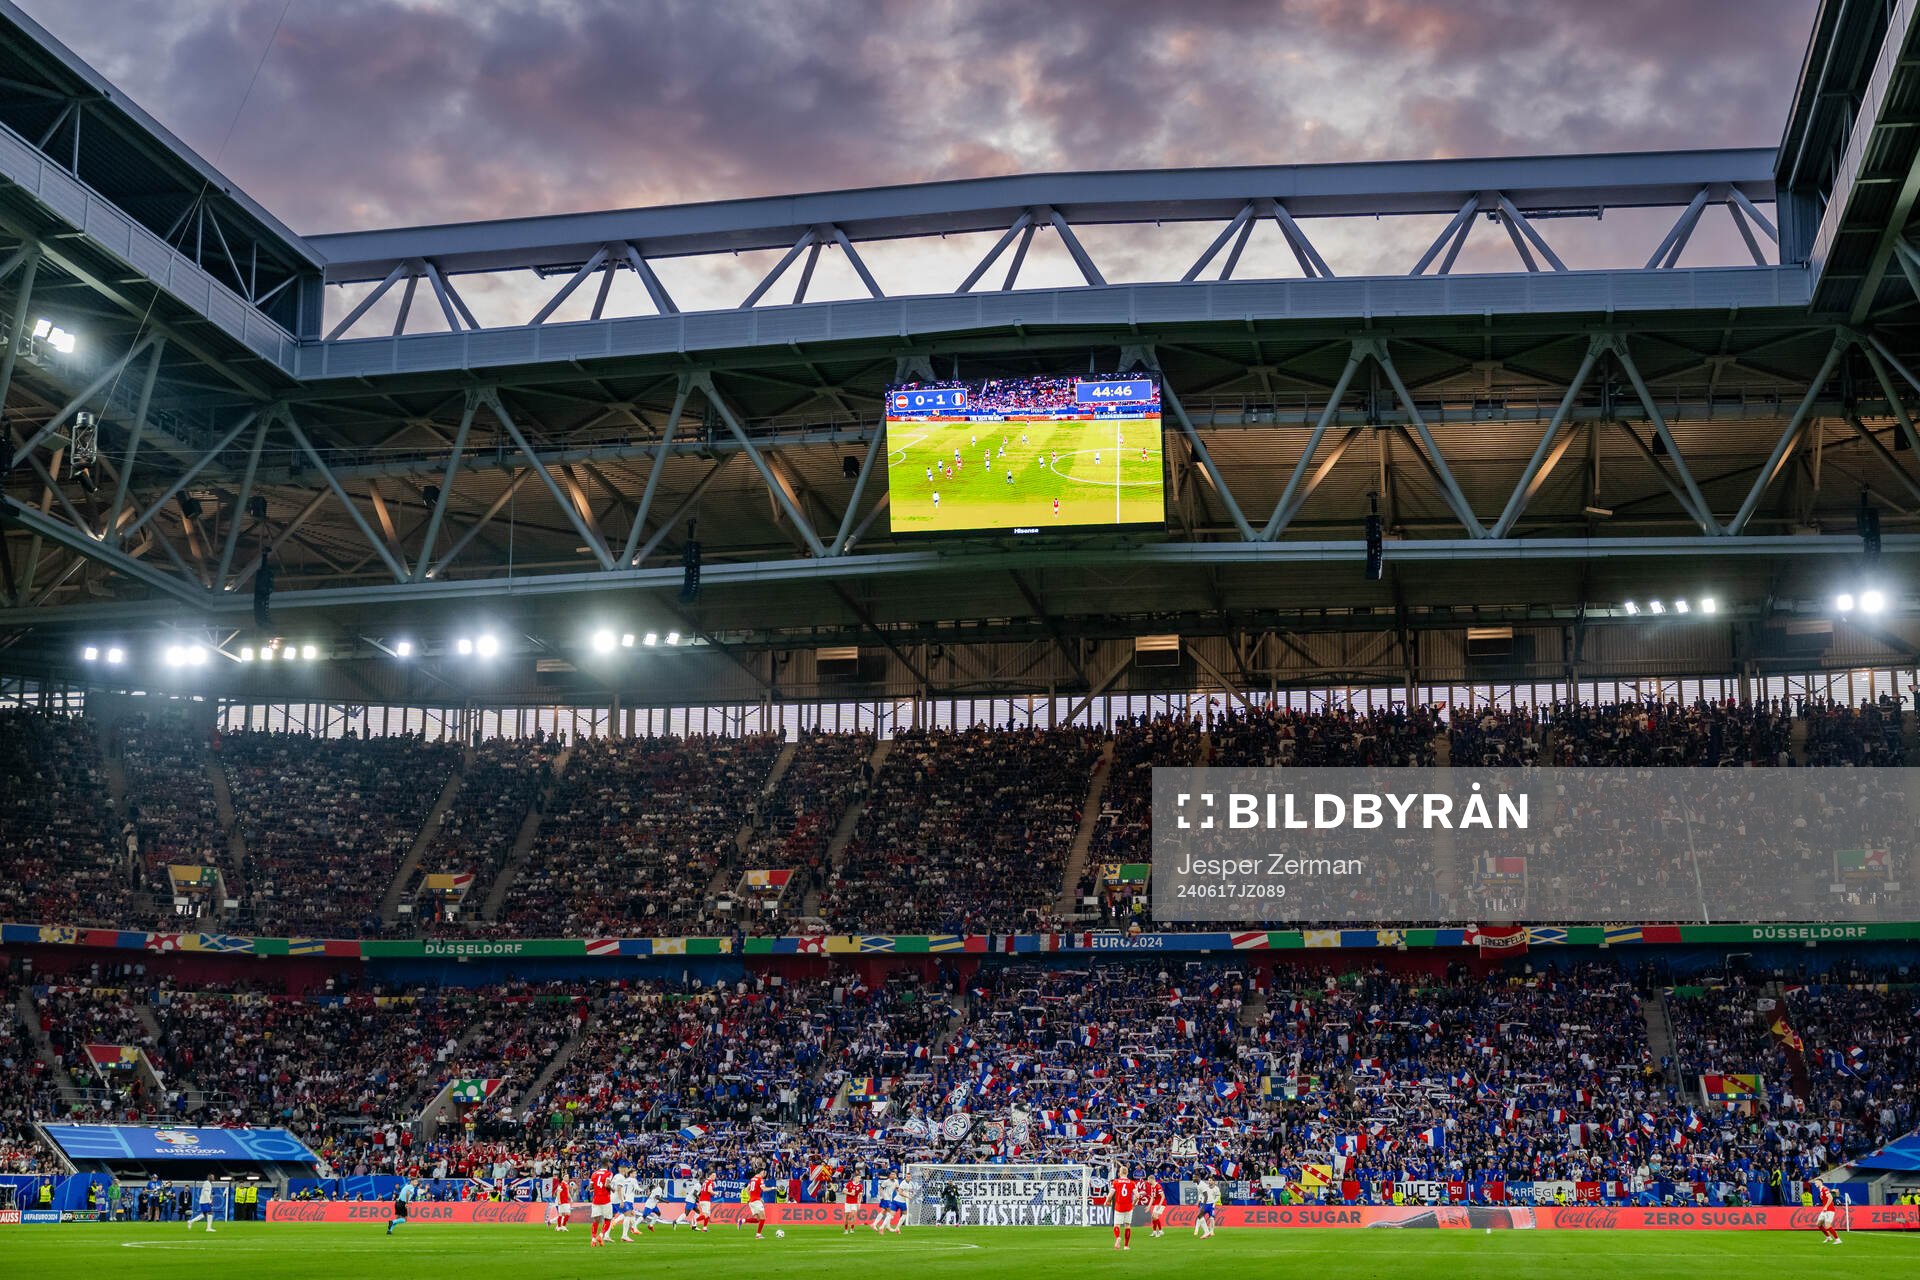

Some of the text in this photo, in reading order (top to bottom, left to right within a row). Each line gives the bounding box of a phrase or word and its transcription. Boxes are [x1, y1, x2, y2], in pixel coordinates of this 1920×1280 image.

[1092, 385, 1132, 398] 44:46
[1753, 926, 1867, 939] DÜSSELDORF
[425, 942, 523, 954] DÜSSELDORF
[597, 1175, 603, 1188] 4
[1122, 1183, 1128, 1197] 6
[0, 1212, 19, 1222] AUSS
[348, 1206, 392, 1219] ZERO
[406, 1206, 453, 1219] UGAR
[782, 1208, 828, 1221] ZERO
[975, 1204, 1028, 1226] TASTE
[1031, 1204, 1061, 1226] YOU
[1244, 1210, 1293, 1224] ZERO
[1298, 1210, 1361, 1224] SUGAR
[1644, 1212, 1695, 1226] ZERO
[1701, 1212, 1767, 1226] SUGAR
